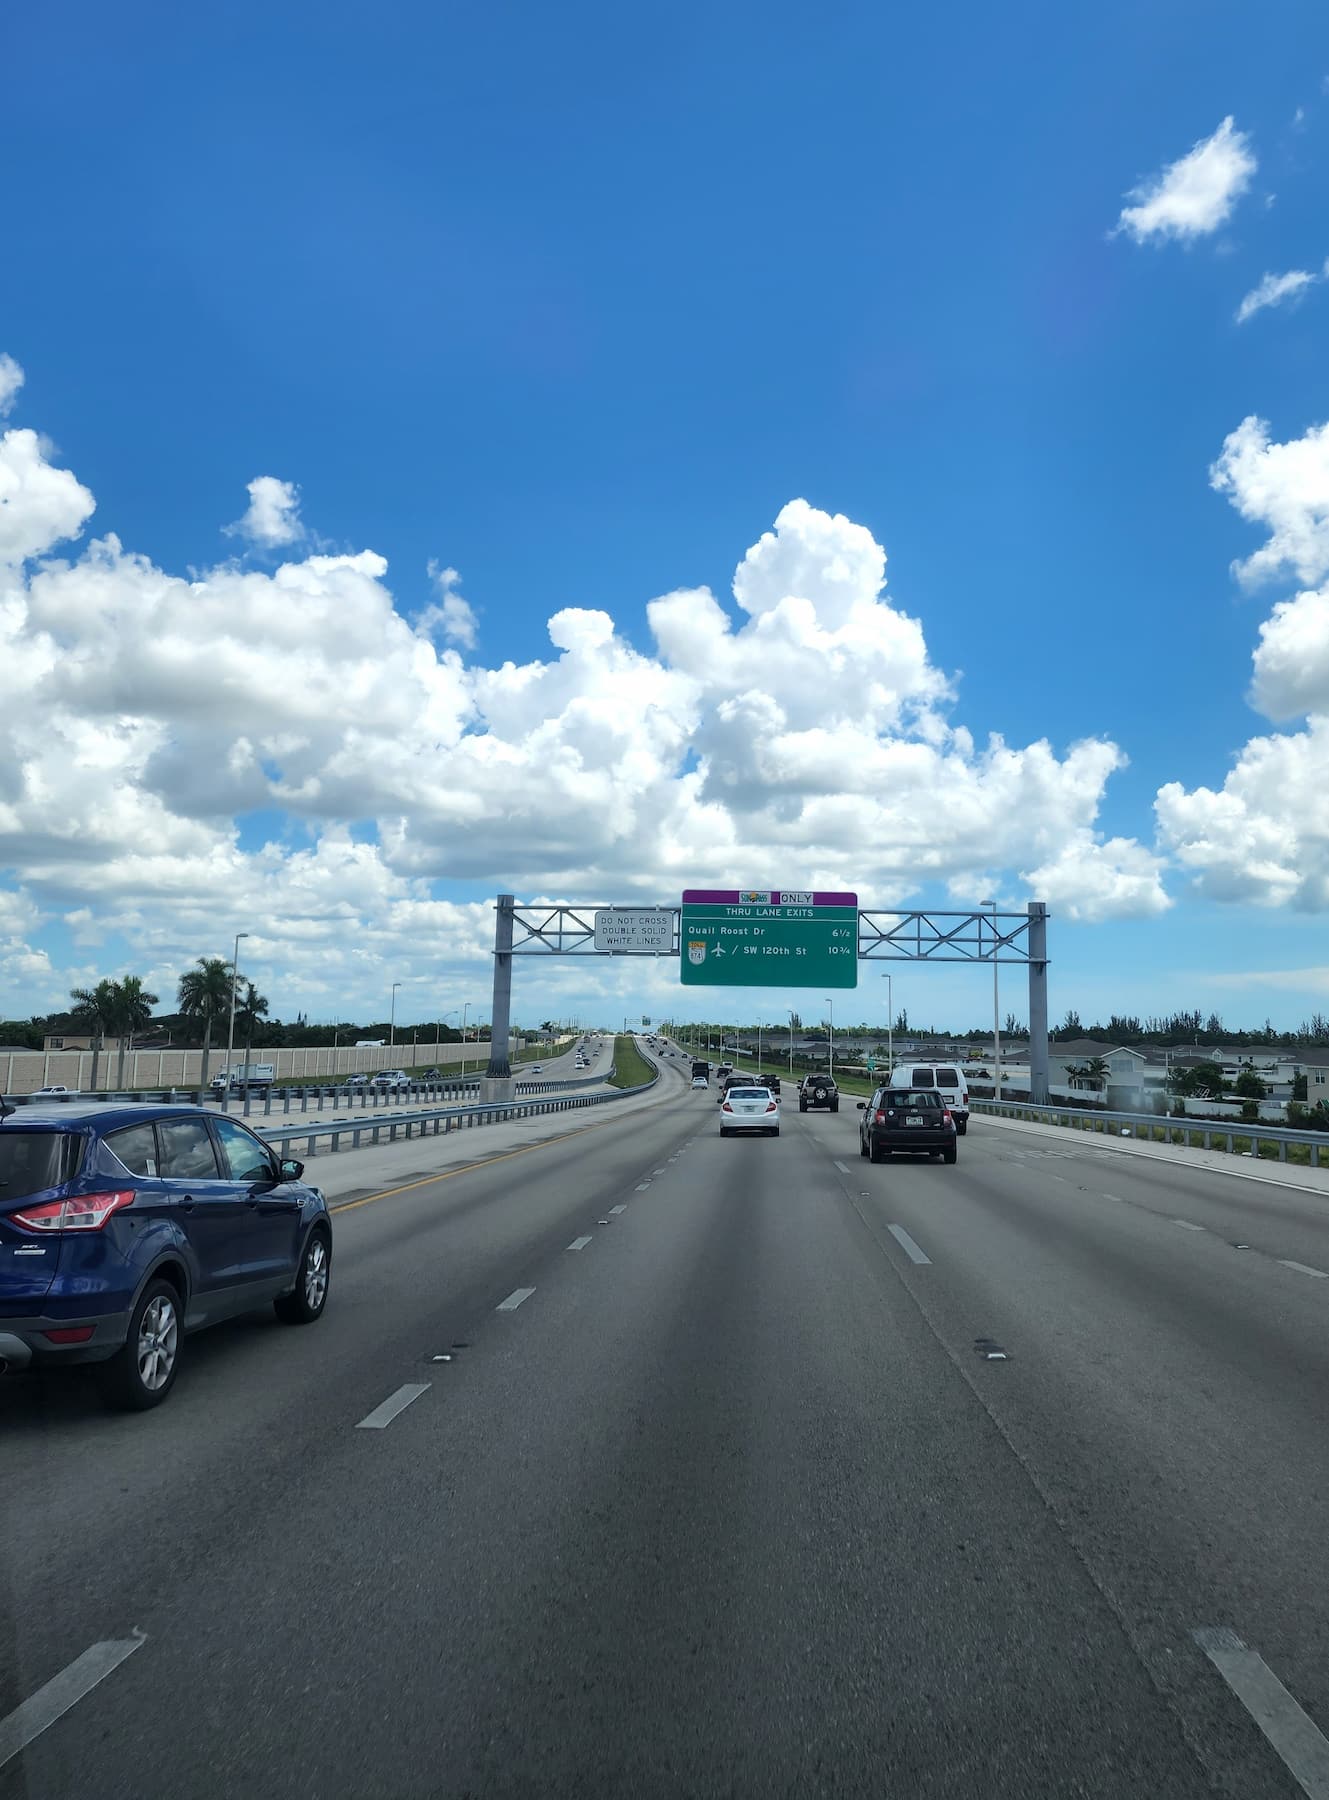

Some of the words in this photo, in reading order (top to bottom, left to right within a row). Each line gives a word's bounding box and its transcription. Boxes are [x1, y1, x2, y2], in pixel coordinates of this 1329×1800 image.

[781, 894, 812, 903] ONLY
[726, 907, 751, 916] THRU
[756, 908, 782, 917] LANE
[787, 909, 814, 917] EXITS
[602, 927, 637, 935] DOUBLE
[641, 927, 667, 935] SOLID
[688, 926, 715, 935] Quail
[720, 927, 748, 935] Roost
[753, 927, 766, 936] Dr
[606, 937, 633, 945] WHITE
[636, 937, 662, 945] LINES
[743, 946, 758, 954] SW
[762, 946, 790, 955] 120th
[795, 947, 808, 955] St
